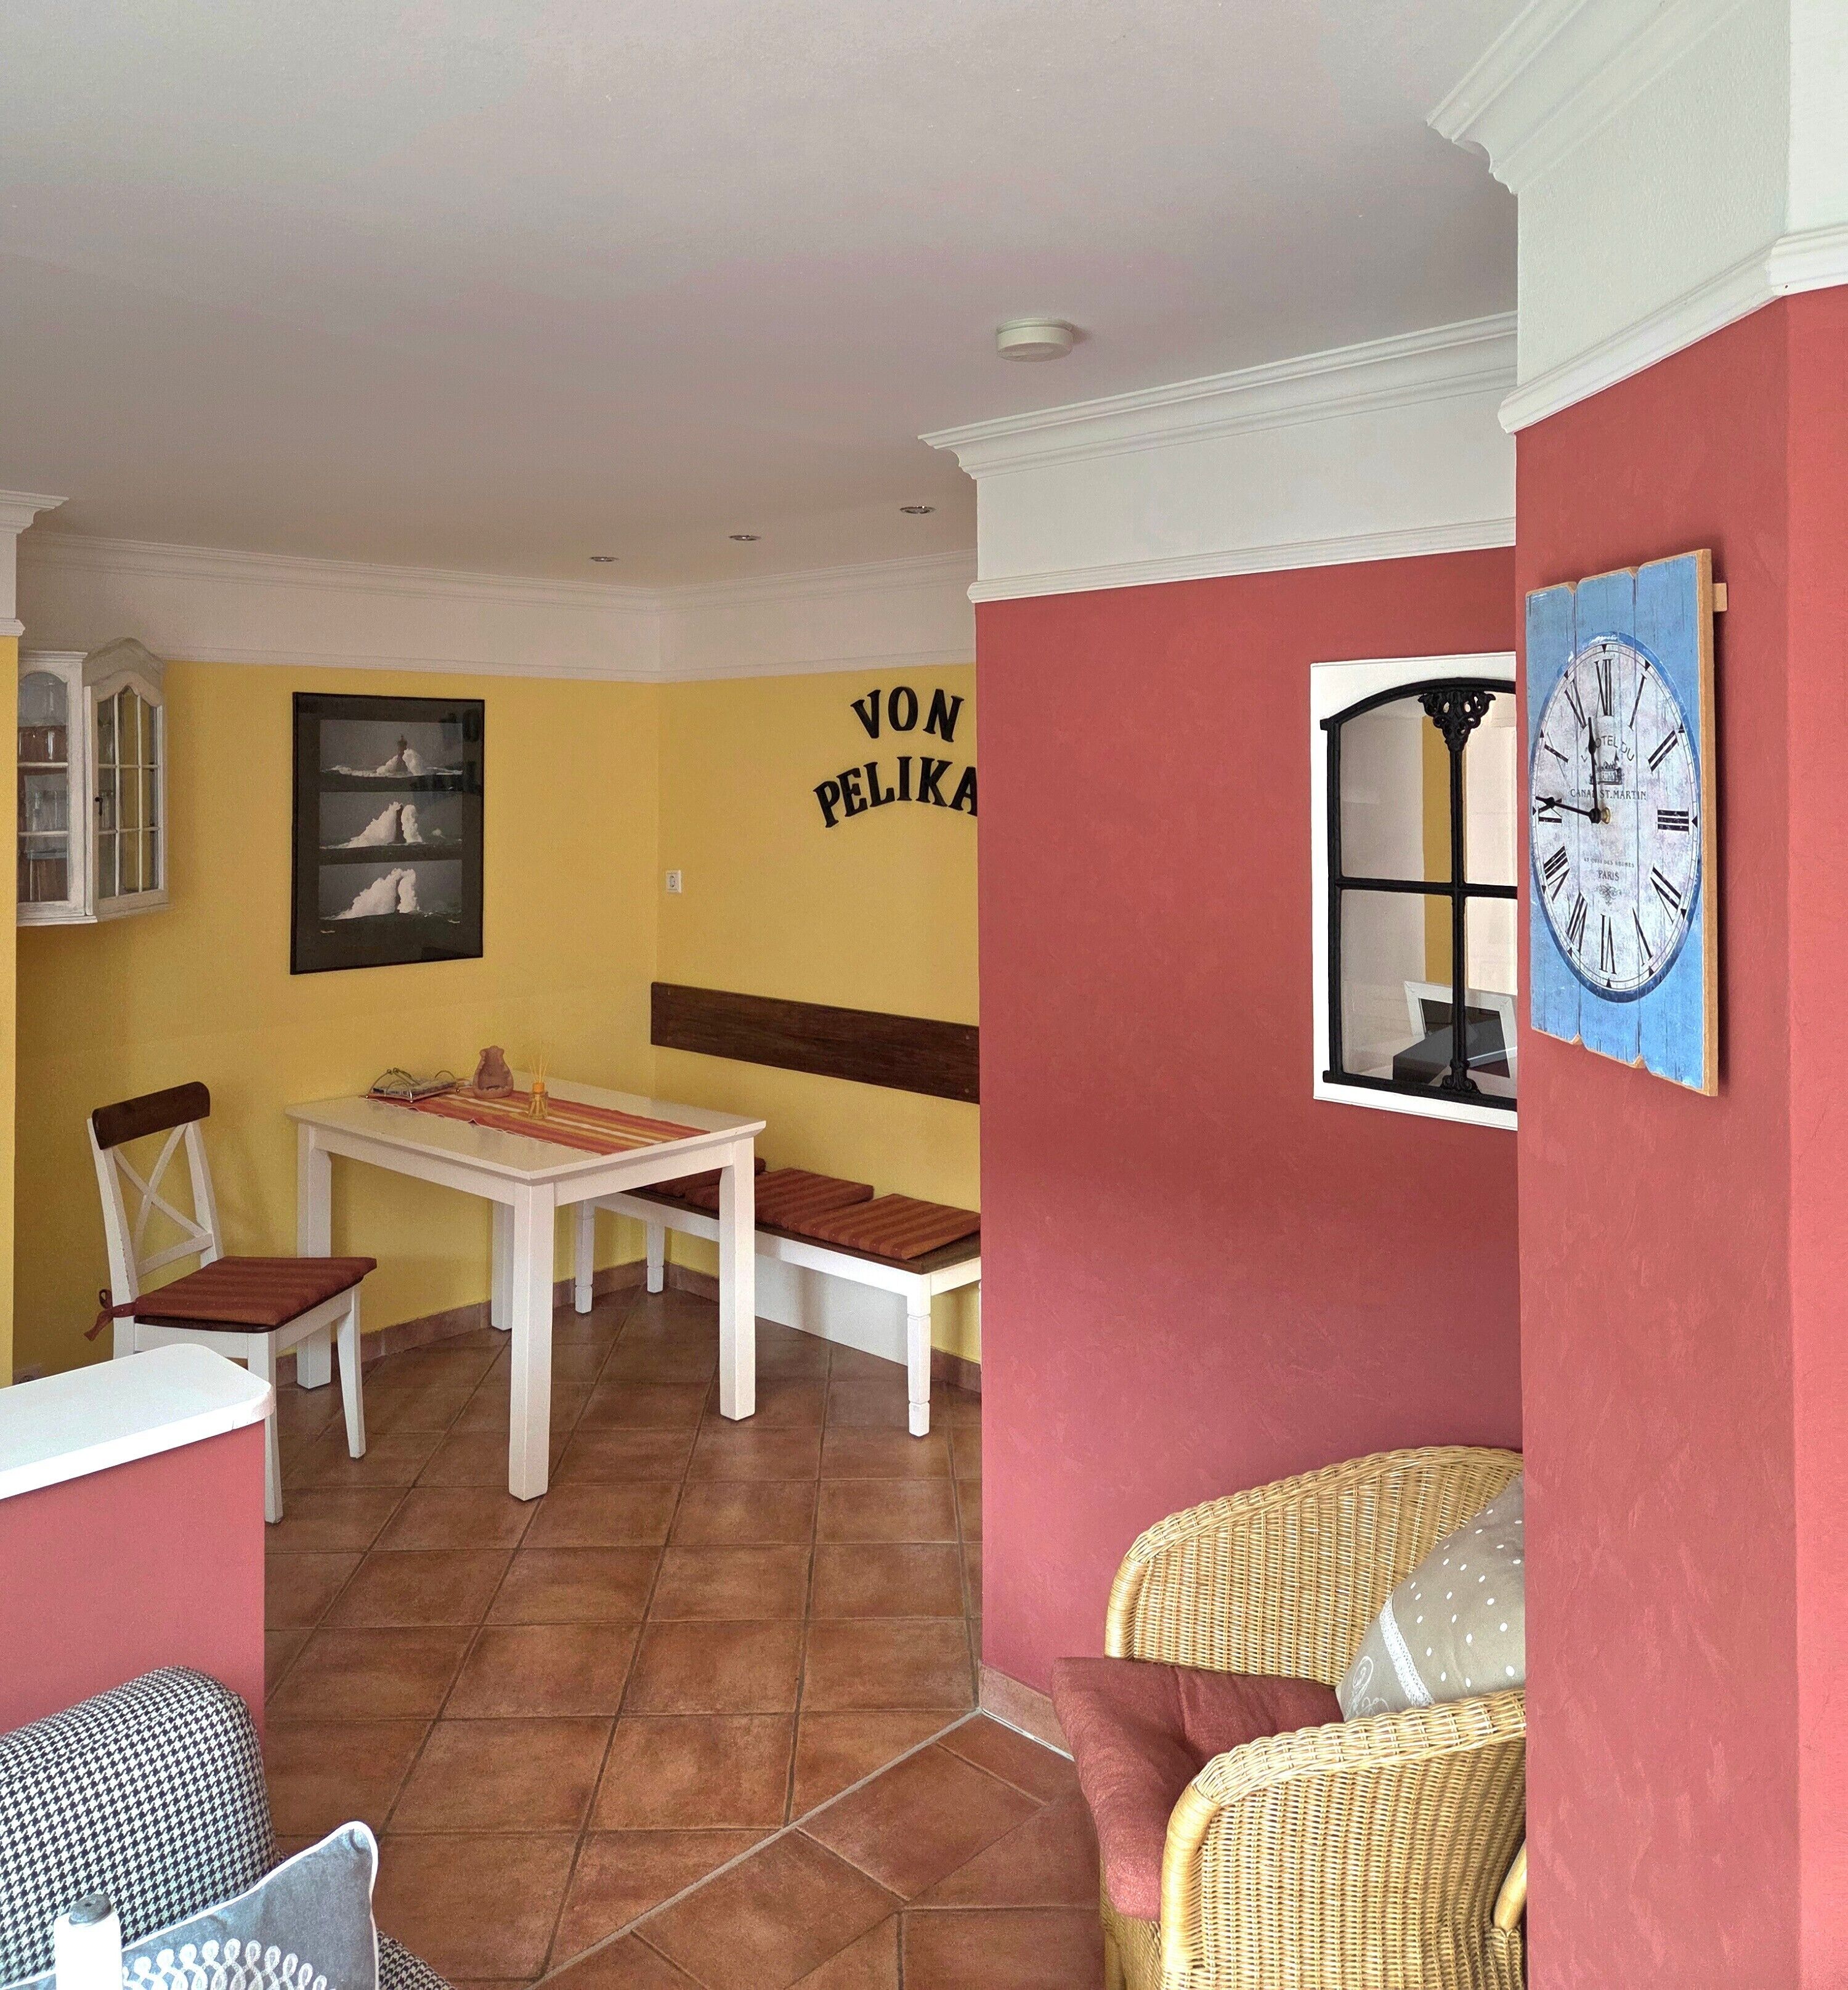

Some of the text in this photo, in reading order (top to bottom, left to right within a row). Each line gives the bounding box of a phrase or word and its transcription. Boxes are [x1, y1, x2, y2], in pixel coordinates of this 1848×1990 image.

[1595, 659, 1613, 718] XII
[850, 686, 965, 742] VON
[1581, 735, 1635, 763] L'OTEL DU
[1657, 809, 1689, 832] III
[1598, 869, 1620, 882] PARIS
[1599, 914, 1617, 975] VI
